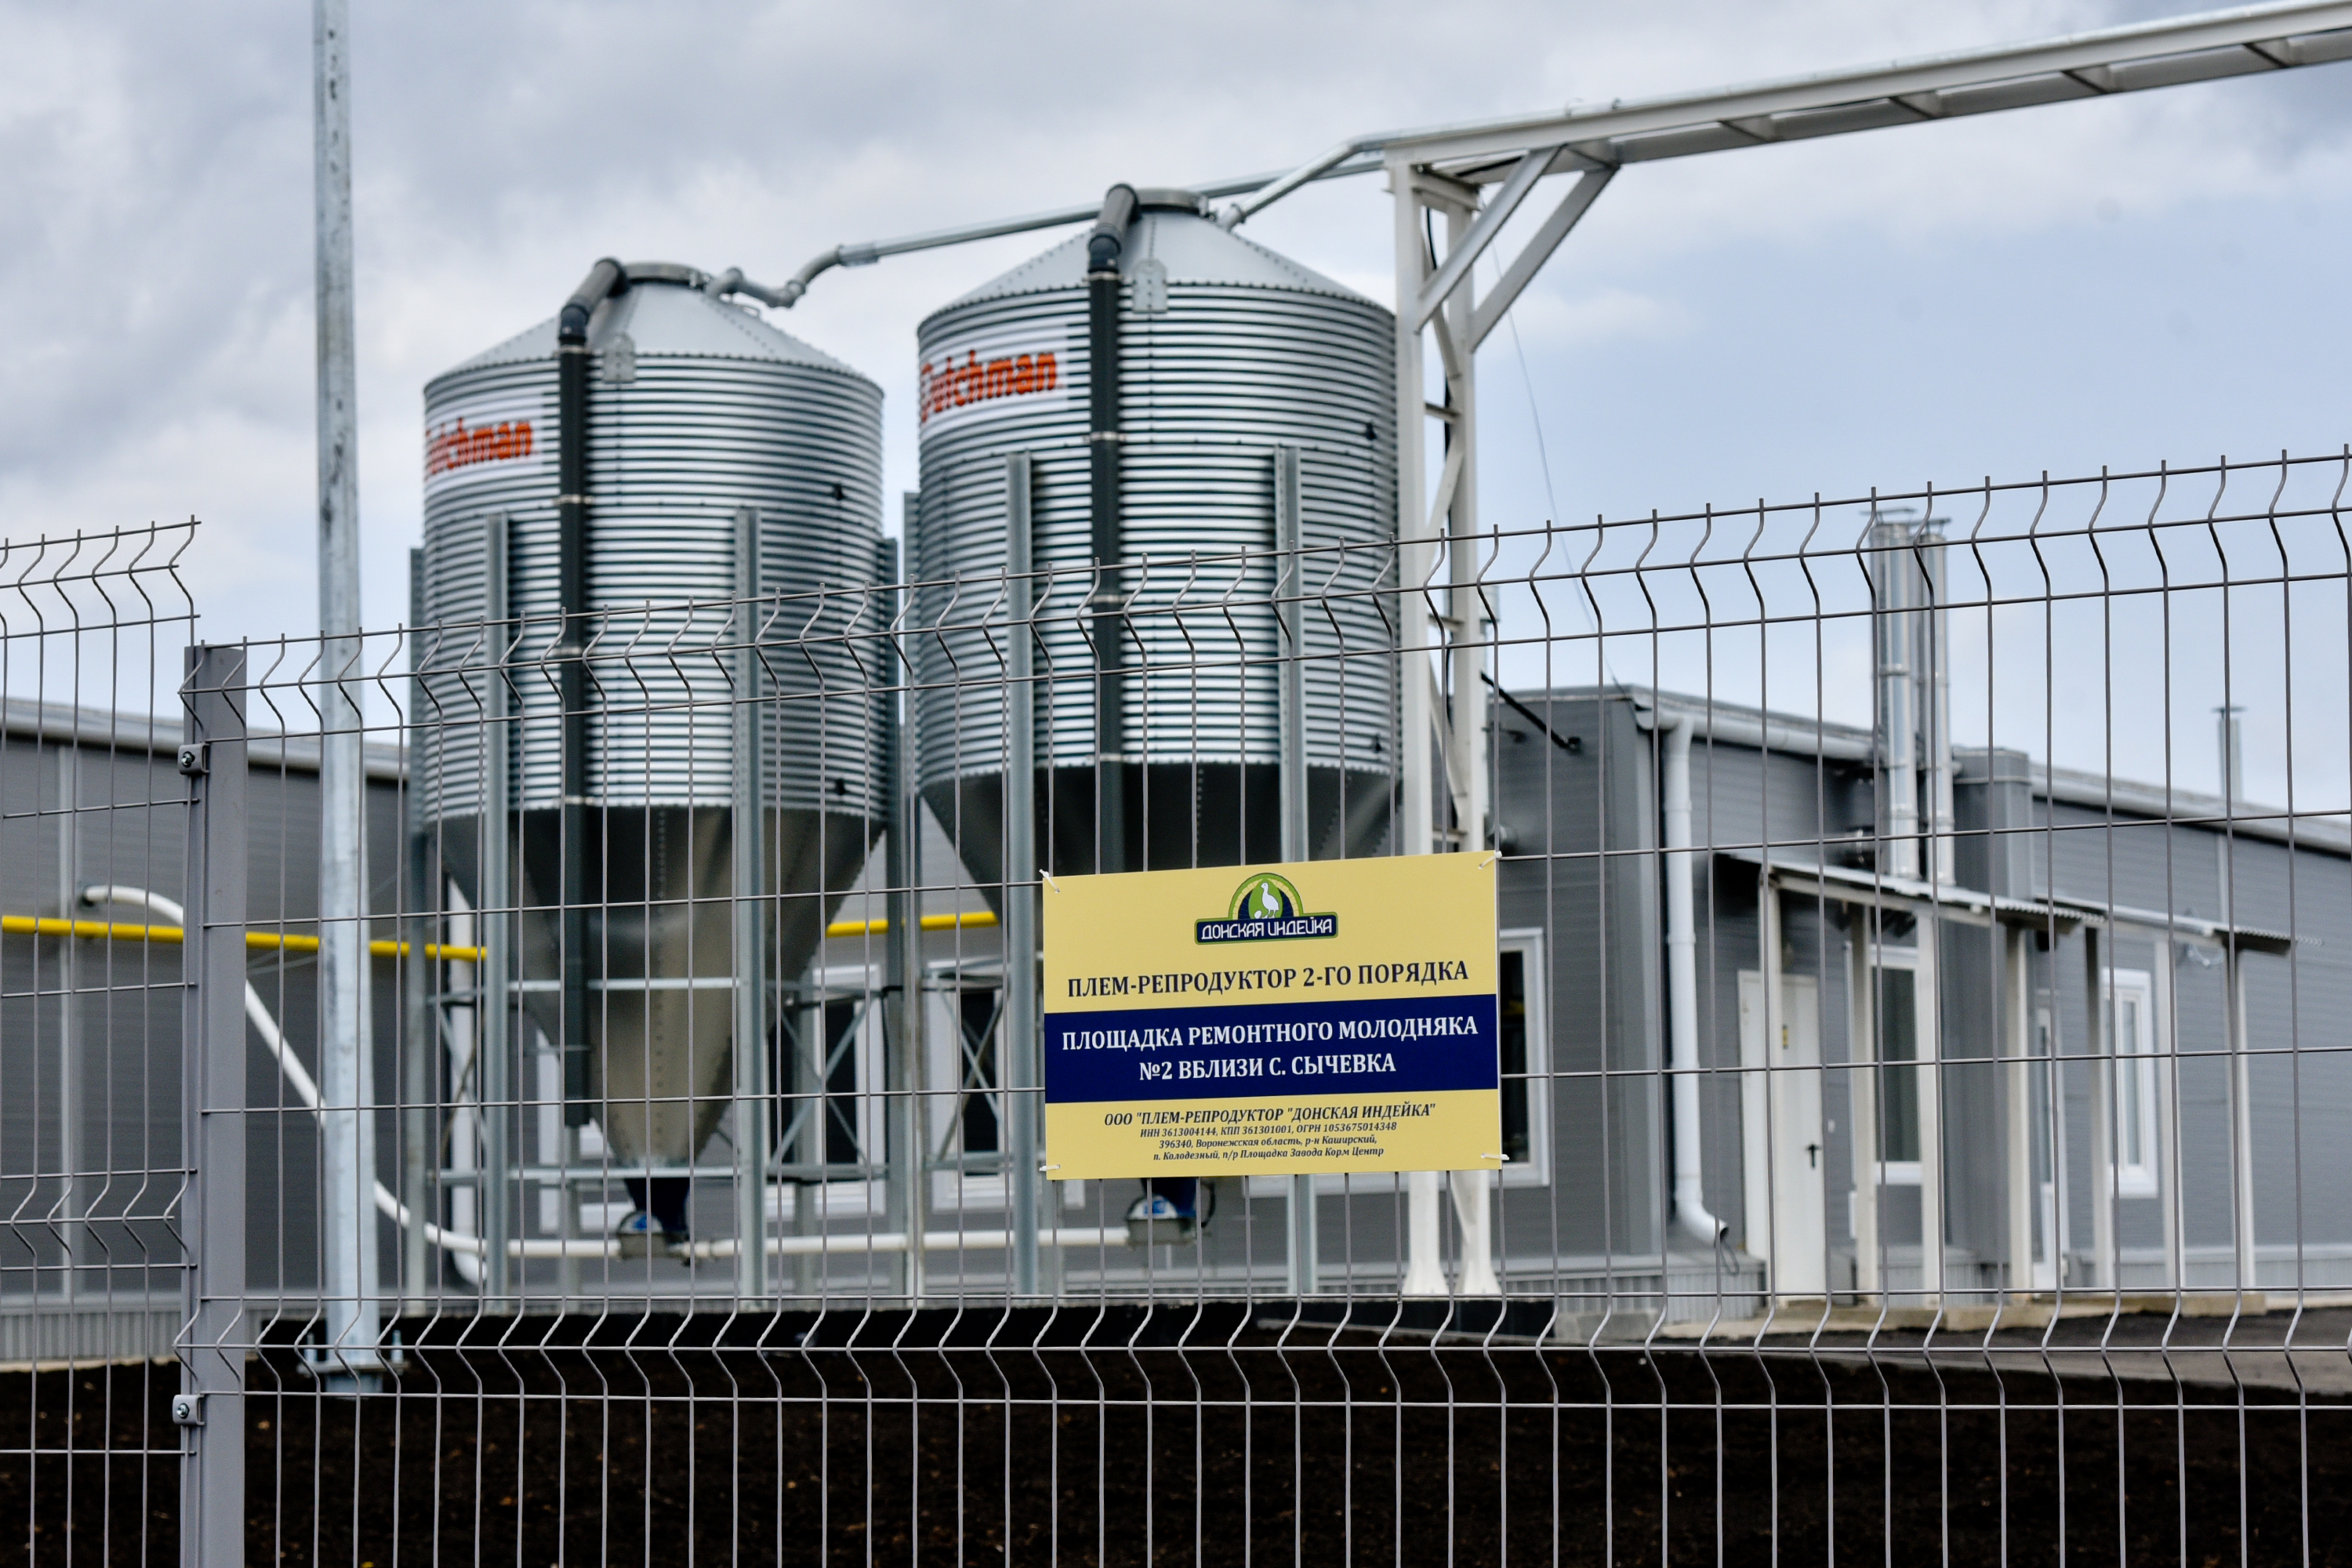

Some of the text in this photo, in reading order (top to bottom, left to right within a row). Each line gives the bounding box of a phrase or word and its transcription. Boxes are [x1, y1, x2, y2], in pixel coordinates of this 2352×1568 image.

[1201, 916, 1332, 939] ДОНСКАЯ ИНДЕЙКА
[1067, 960, 1469, 997] ПЛЕМ-РЕПРОДУКТОР 2-ГО ПОРЯДКА
[1062, 1014, 1479, 1052] ПЛОЩАДКА РЕМОНТНОГО МОЛОДНЯКА
[1138, 1052, 1397, 1081] №2 ВБЛИЗИ С. СЫЧЕВКА
[1105, 1100, 1436, 1126] ООО "ПЛЕМ-РЕПРОДУКТОР "ДОНСКАЯ ИНДЕЙКА"
[1140, 1121, 1397, 1138] ИНН 3613004144, КПП 361301001, ОГРН 1053675014348
[1159, 1134, 1377, 1149] 396340, Воронежская область, р-н Каширский,
[1163, 1151, 1220, 1160] Колодезный,
[1222, 1150, 1239, 1161] п/р
[1240, 1148, 1288, 1159] Площадка
[1290, 1148, 1323, 1157] Завода
[1324, 1147, 1349, 1157] Корм
[1352, 1146, 1384, 1156] Центр
